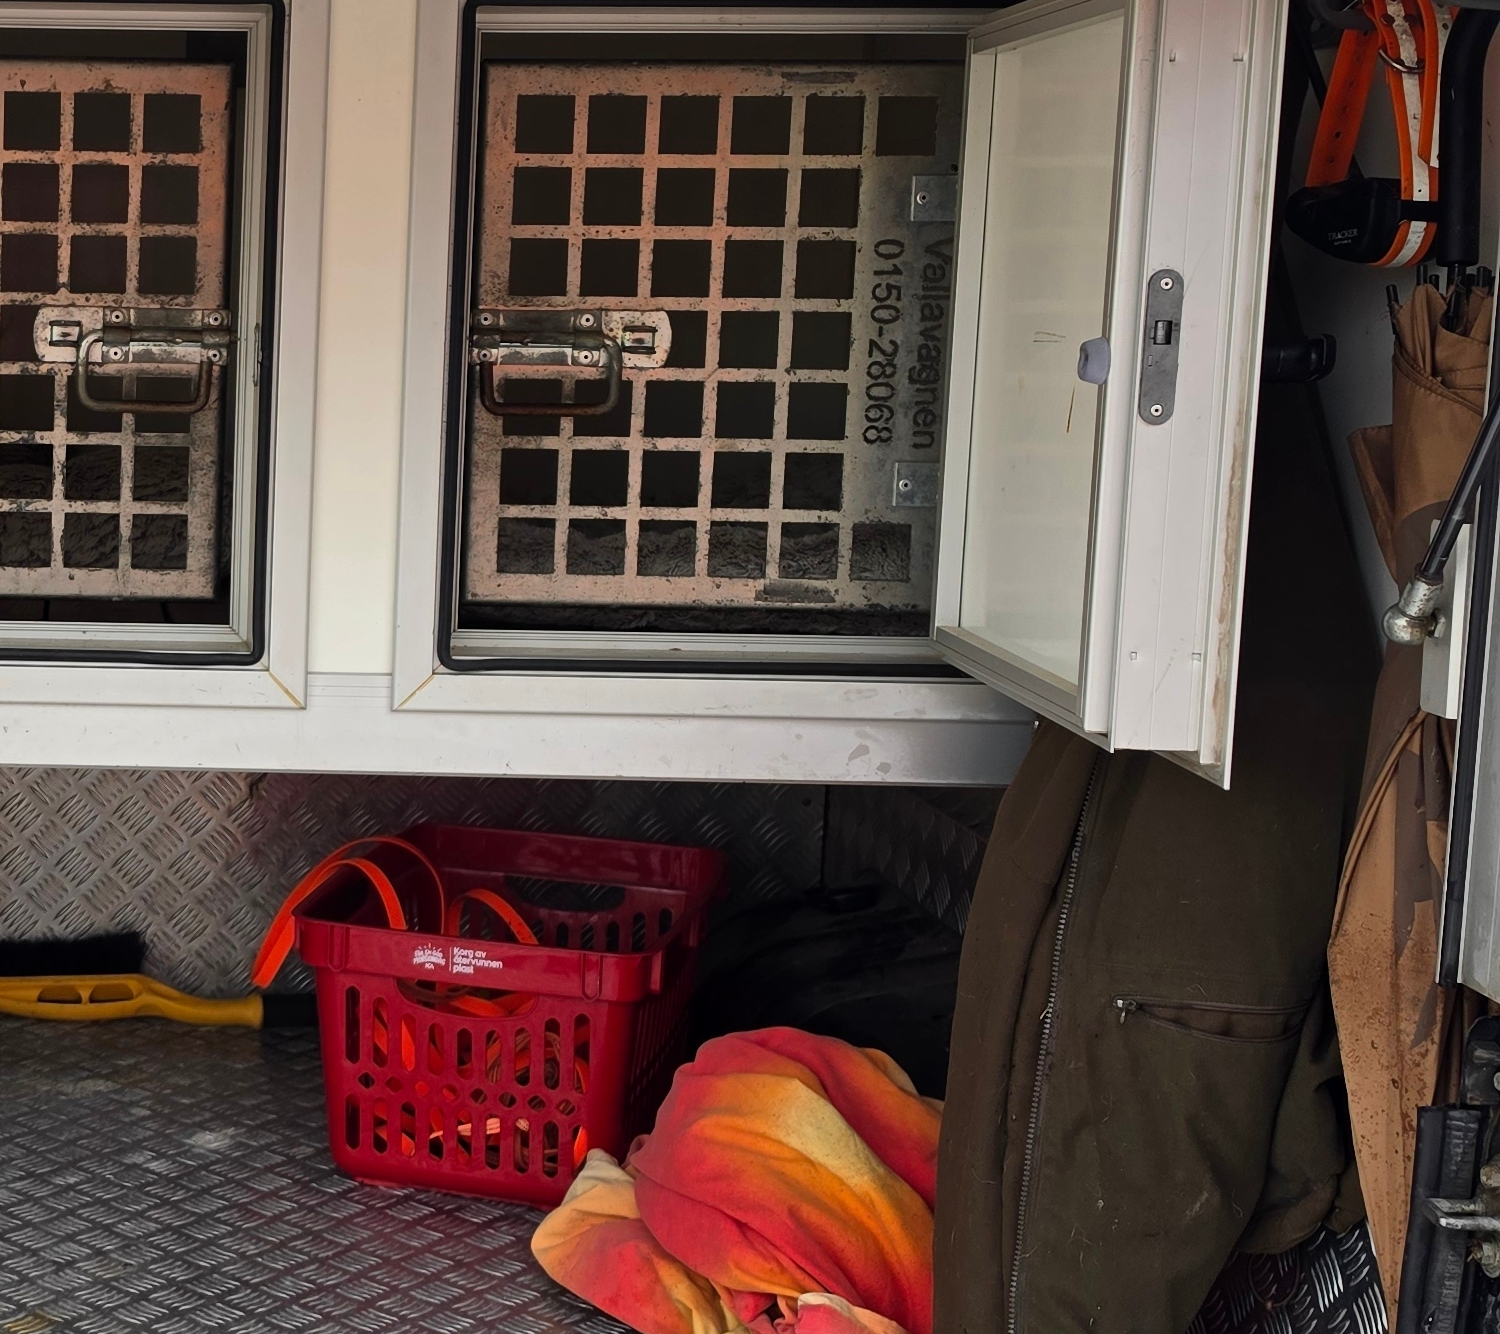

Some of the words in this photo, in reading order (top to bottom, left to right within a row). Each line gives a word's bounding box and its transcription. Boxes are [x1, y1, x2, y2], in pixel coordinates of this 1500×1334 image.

[862, 238, 906, 445] 0150-28068
[907, 236, 954, 450] Vallavagnen
[453, 946, 474, 959] Korg
[474, 950, 487, 958] av
